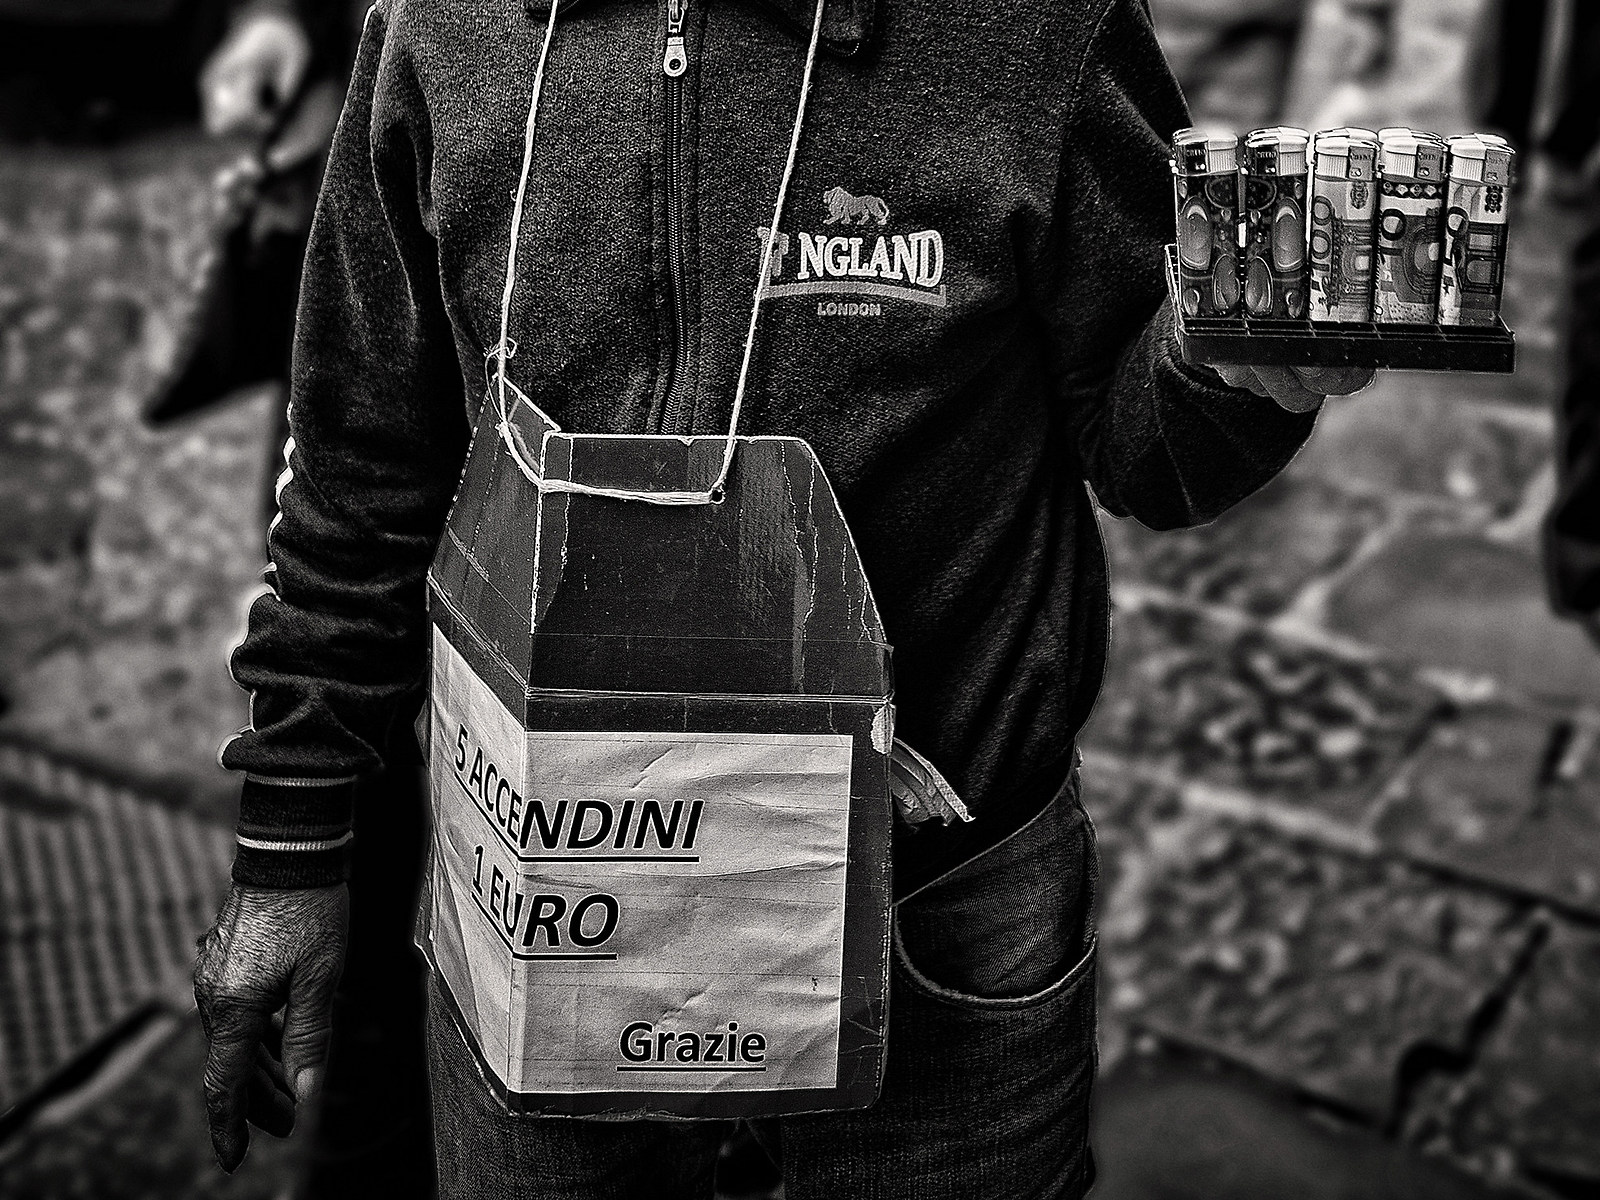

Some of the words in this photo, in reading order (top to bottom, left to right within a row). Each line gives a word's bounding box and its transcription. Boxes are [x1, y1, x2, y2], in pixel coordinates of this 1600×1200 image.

[817, 303, 881, 316] LONDON
[455, 723, 468, 772] 5
[469, 746, 704, 850] ACCENDINI
[472, 845, 483, 897] 1
[490, 864, 619, 948] EURO
[620, 1022, 766, 1063] Grazie
